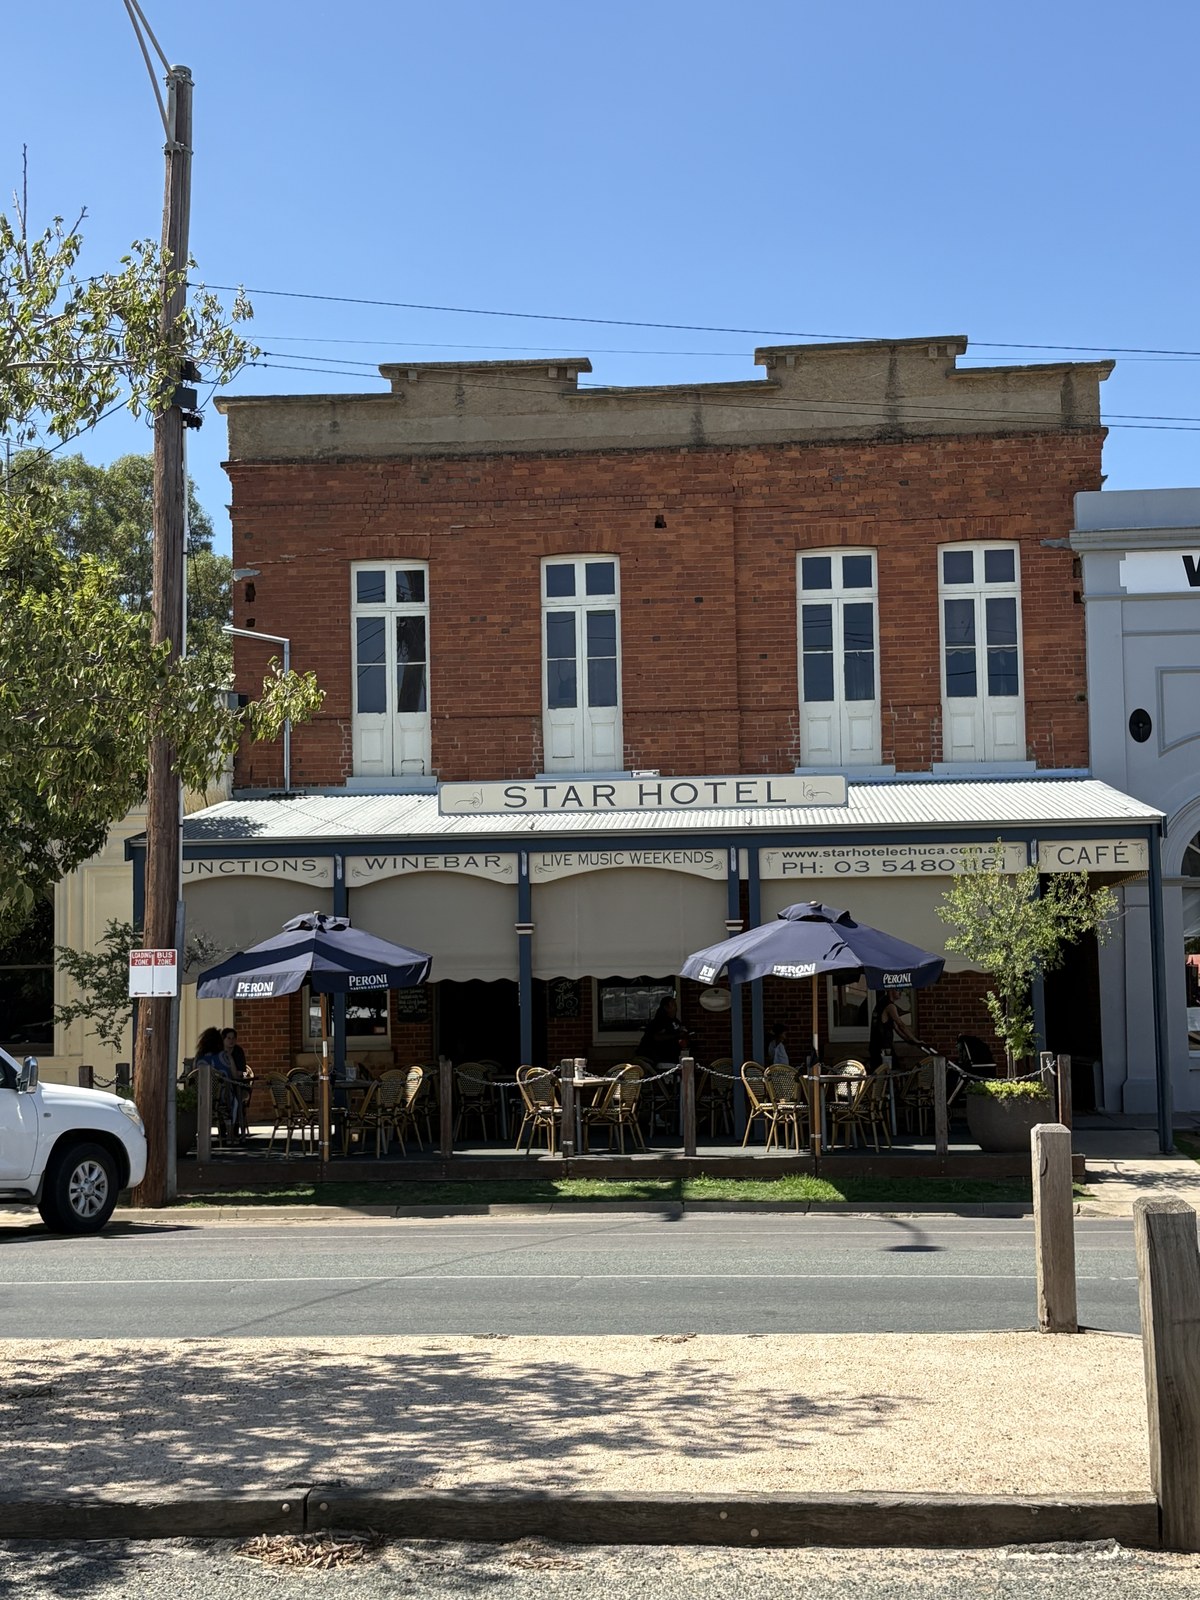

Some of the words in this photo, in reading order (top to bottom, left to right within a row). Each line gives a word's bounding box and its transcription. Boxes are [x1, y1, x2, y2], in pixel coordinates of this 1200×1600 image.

[503, 784, 617, 809] STAR
[638, 781, 787, 806] HOTEL
[542, 853, 573, 867] LIVE
[578, 852, 624, 866] MUSIC
[629, 850, 714, 865] WEEKENDS
[1057, 841, 1130, 865] CAFÉ
[364, 855, 501, 870] WINEBAR
[782, 861, 824, 875] PH:
[834, 860, 870, 874] 03
[134, 958, 149, 966] ZONE
[156, 951, 173, 959] BUS
[773, 962, 816, 974] PERONI
[348, 973, 388, 987] PERONI
[882, 972, 912, 984] PERONI
[237, 981, 274, 993] PERONI
